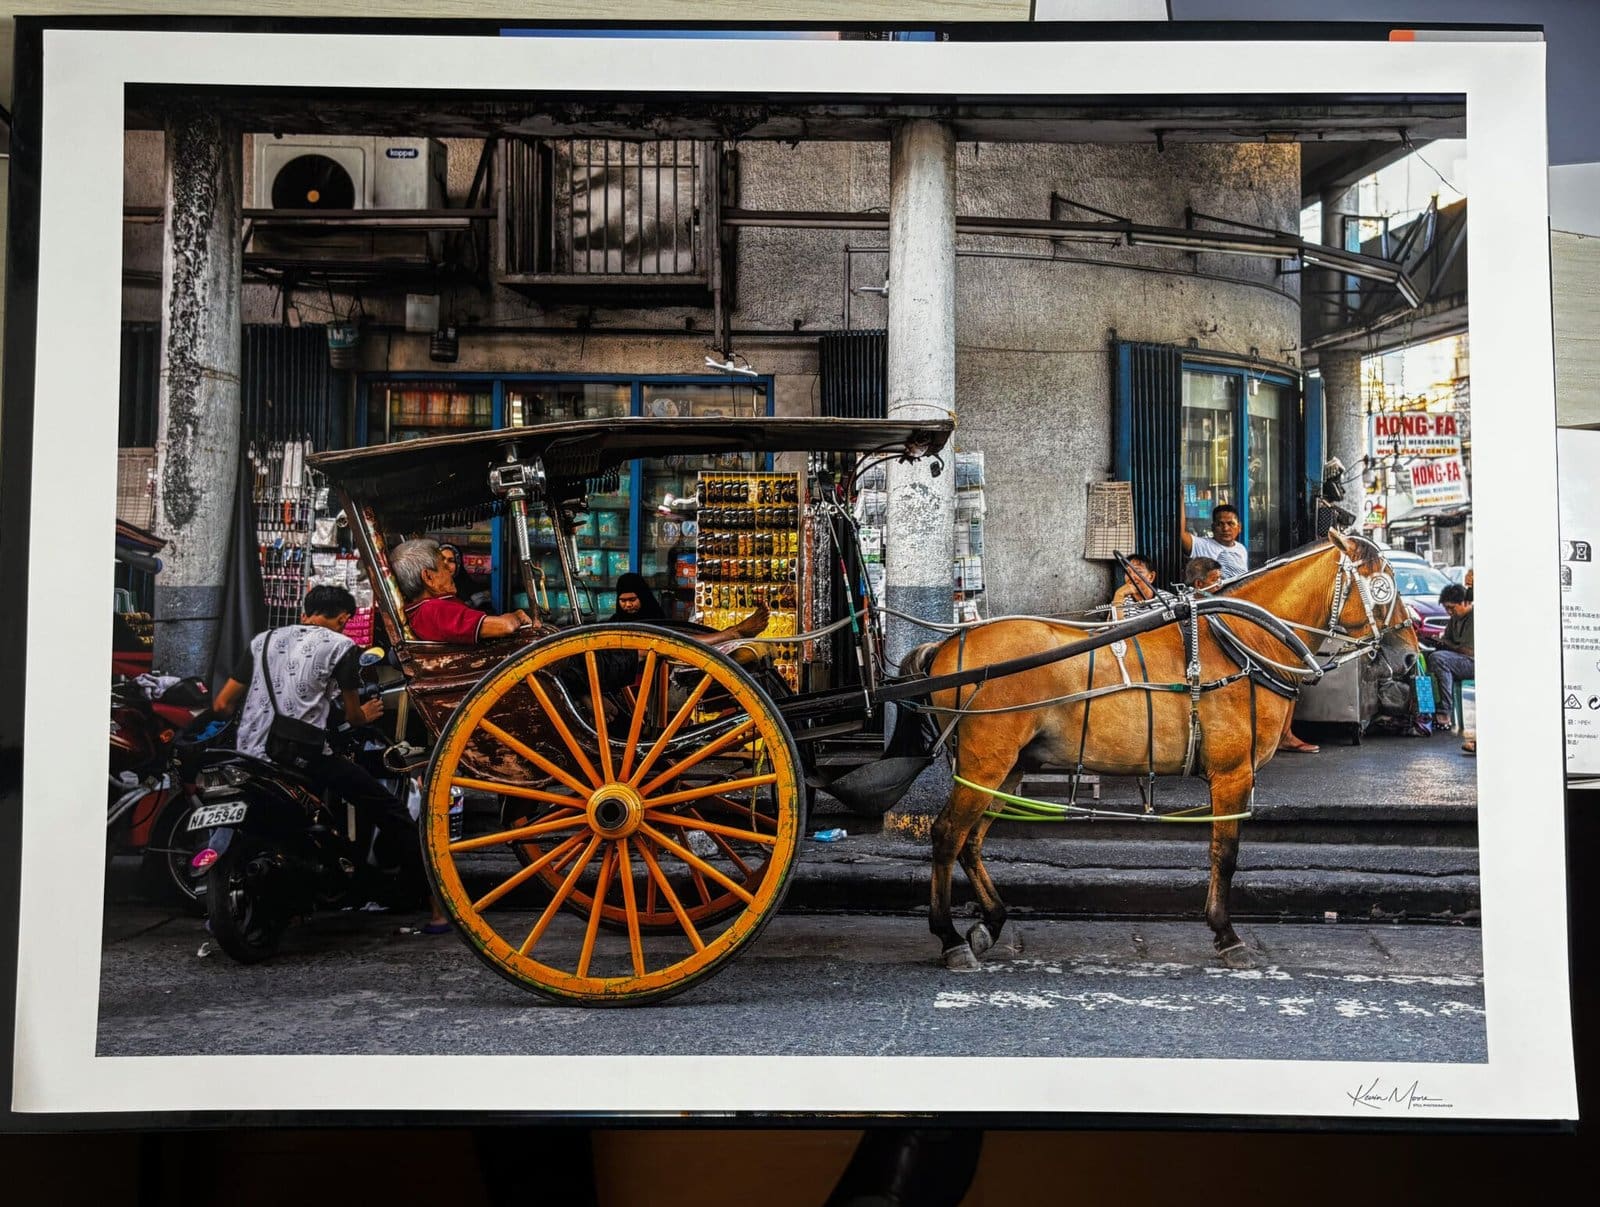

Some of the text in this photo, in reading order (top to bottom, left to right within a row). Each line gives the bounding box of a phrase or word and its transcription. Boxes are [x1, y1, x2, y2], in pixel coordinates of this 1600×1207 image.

[1375, 416, 1456, 435] HONG-FA
[1346, 1077, 1443, 1110] Kevin Moore
